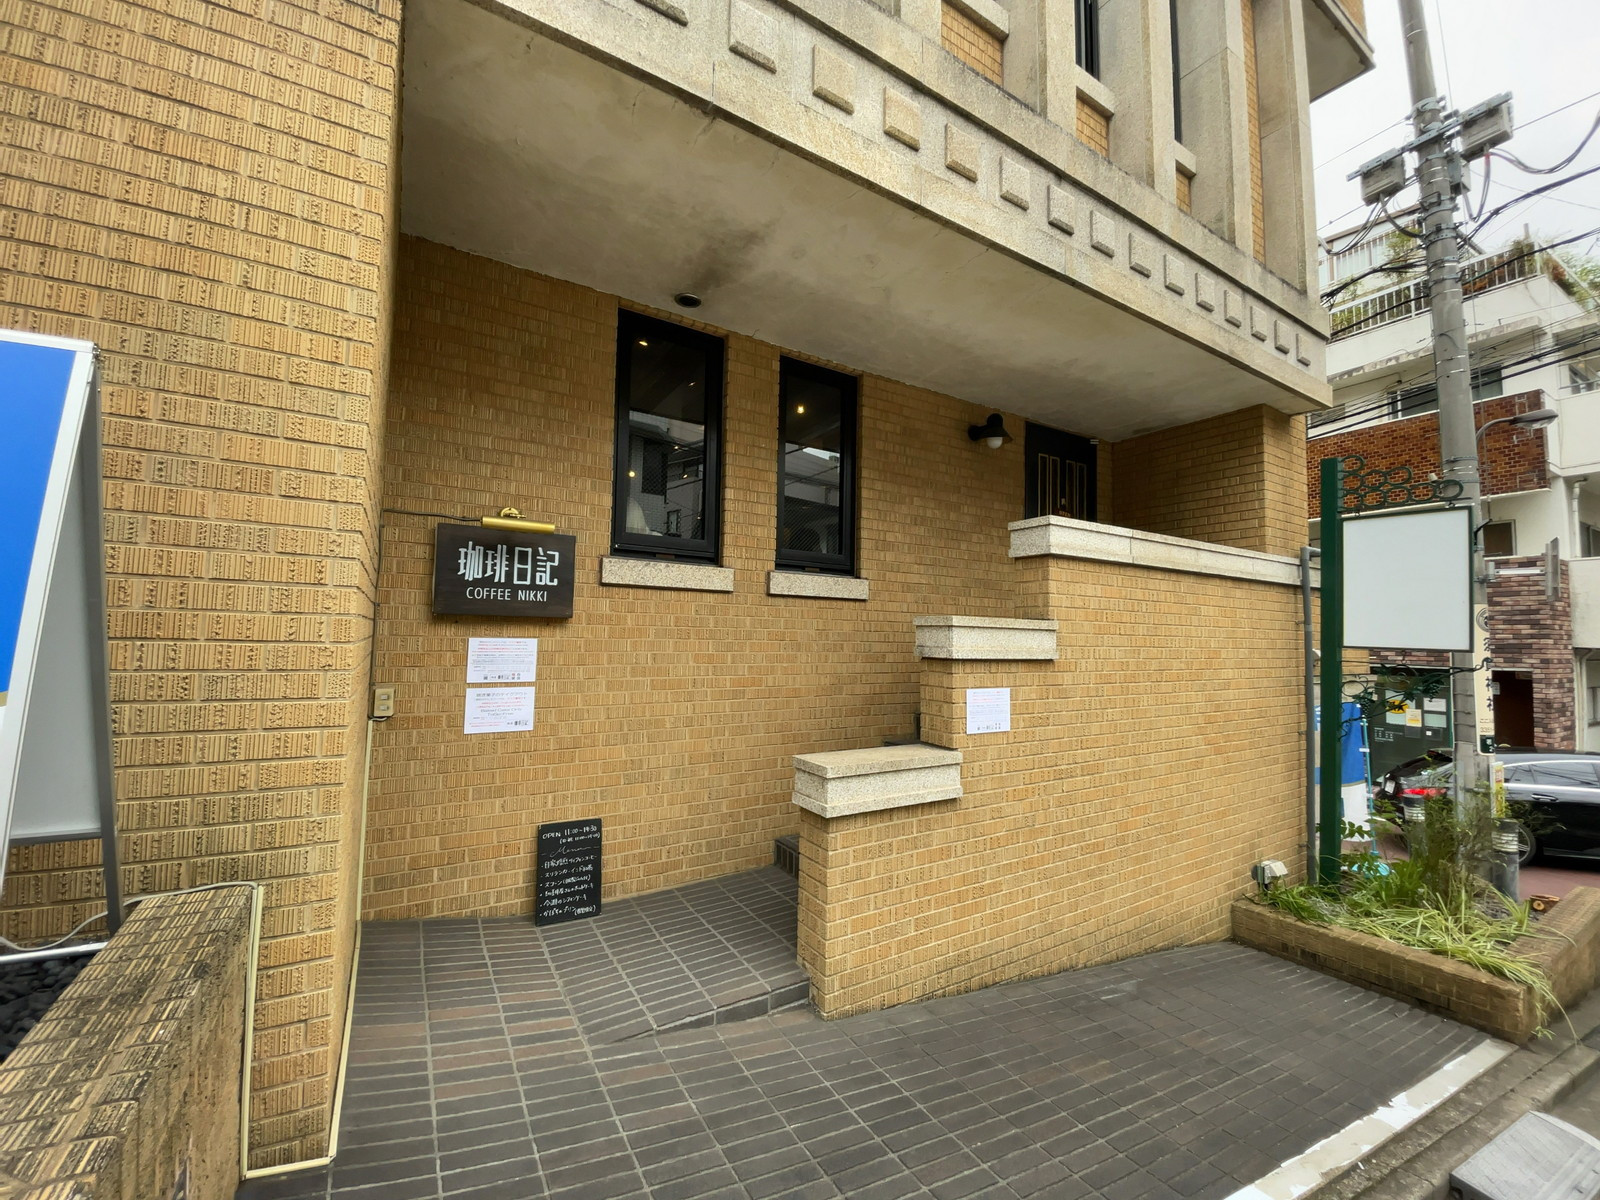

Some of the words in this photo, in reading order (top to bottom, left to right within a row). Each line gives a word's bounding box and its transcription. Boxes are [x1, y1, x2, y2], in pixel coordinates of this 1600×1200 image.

[457, 541, 560, 586] 珈琲日記
[466, 586, 512, 601] COFFEE
[517, 590, 548, 602] NIKKI
[542, 832, 561, 840] OPEN
